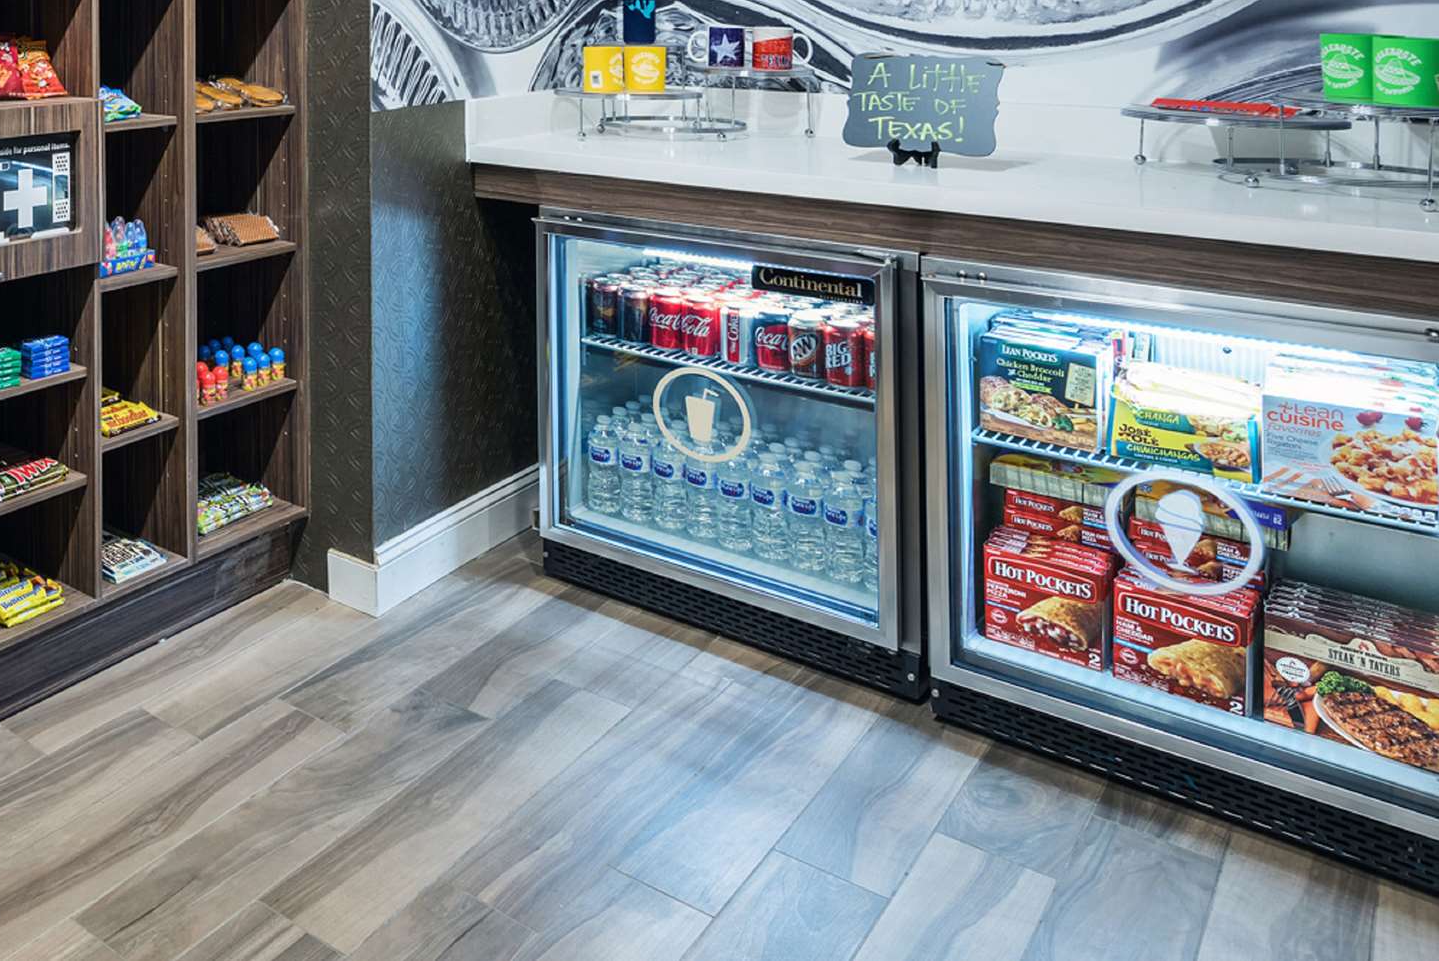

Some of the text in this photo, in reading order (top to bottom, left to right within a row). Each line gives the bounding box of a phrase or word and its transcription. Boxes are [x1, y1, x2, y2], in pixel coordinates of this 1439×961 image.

[867, 62, 892, 88] A
[853, 91, 967, 114] TASTE OF
[868, 116, 964, 143] TEXAS!
[759, 268, 864, 298] Continental
[825, 341, 847, 356] BIG
[825, 353, 852, 369] RED
[996, 358, 1030, 369] Chicken
[8, 457, 59, 482] TWIX
[994, 561, 1092, 599] HOT POCKETS
[1125, 597, 1236, 643] HOT POCKETS
[1088, 652, 1101, 664] 2
[1328, 648, 1355, 664] STEAK
[1369, 659, 1400, 676] TATERS
[1229, 701, 1244, 715] 2
